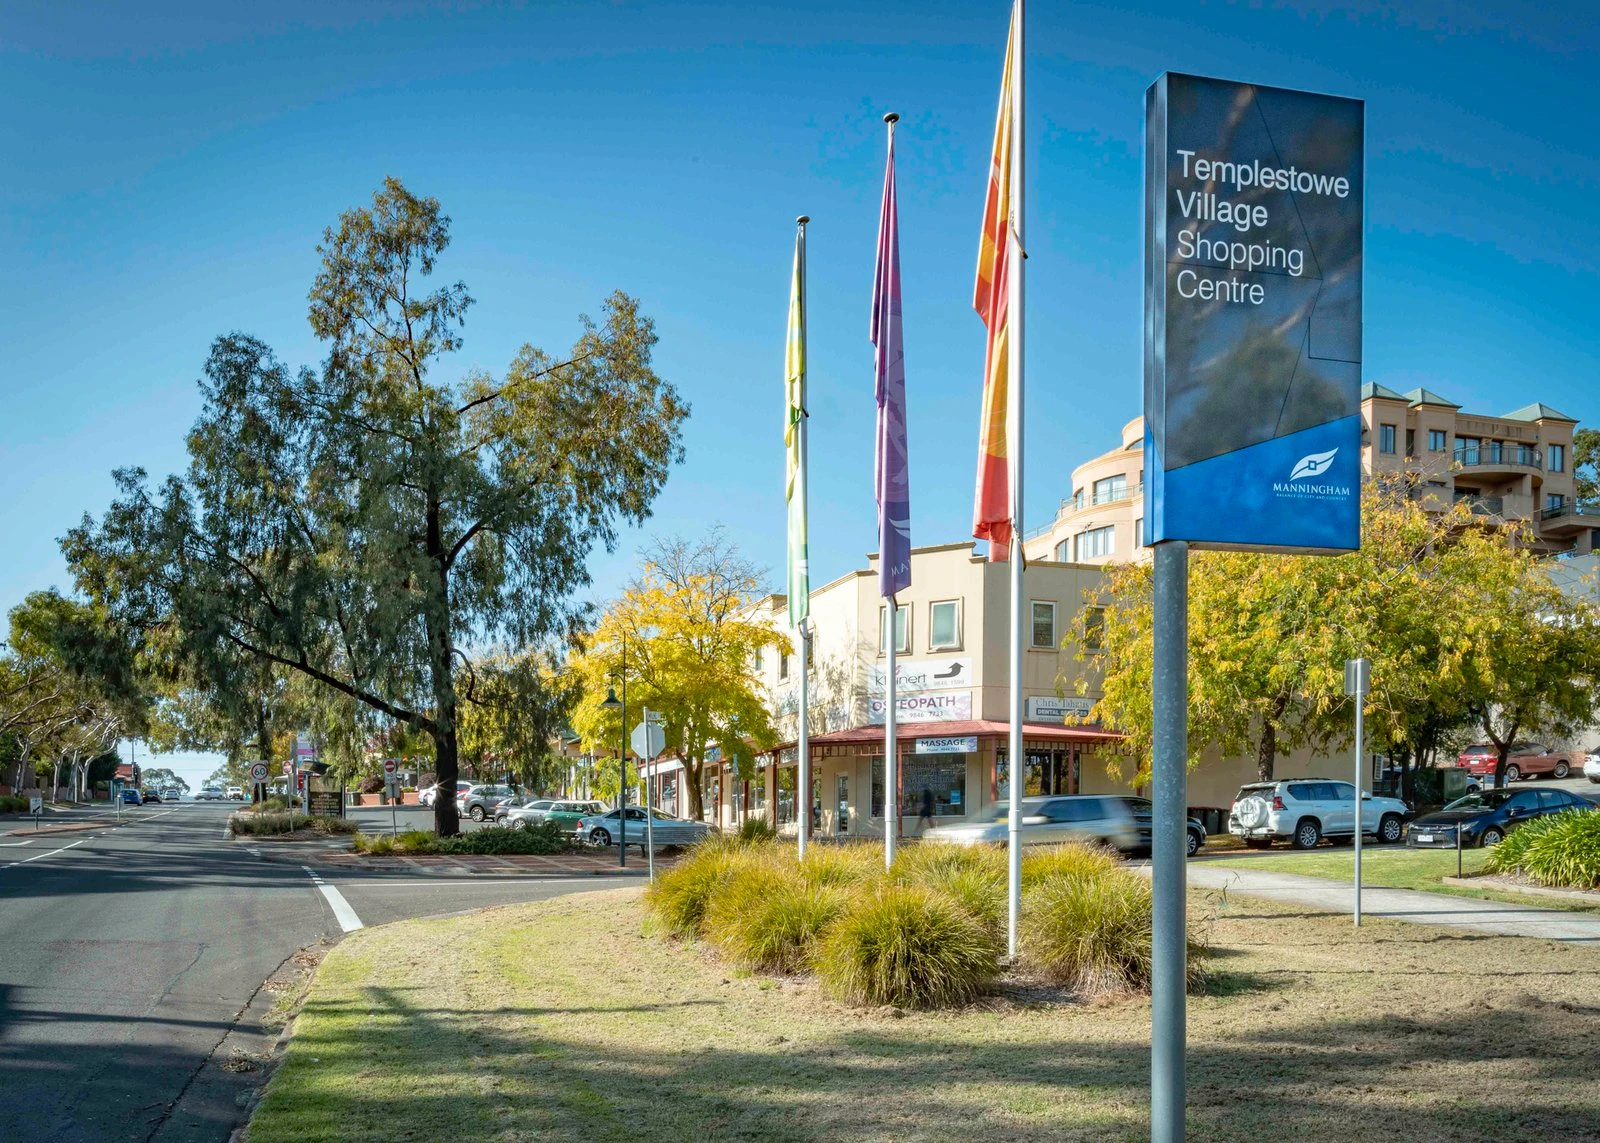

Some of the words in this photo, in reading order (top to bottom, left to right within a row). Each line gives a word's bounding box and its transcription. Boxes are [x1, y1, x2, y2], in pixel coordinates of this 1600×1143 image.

[1176, 149, 1350, 198] Templestowe
[1176, 189, 1268, 232] Village
[1177, 229, 1304, 277] Shopping
[1177, 269, 1265, 305] Centre
[1273, 483, 1350, 496] MANNINGHAM
[891, 560, 911, 576] MA
[875, 673, 927, 686] Klinert
[921, 738, 966, 747] MASSAGE
